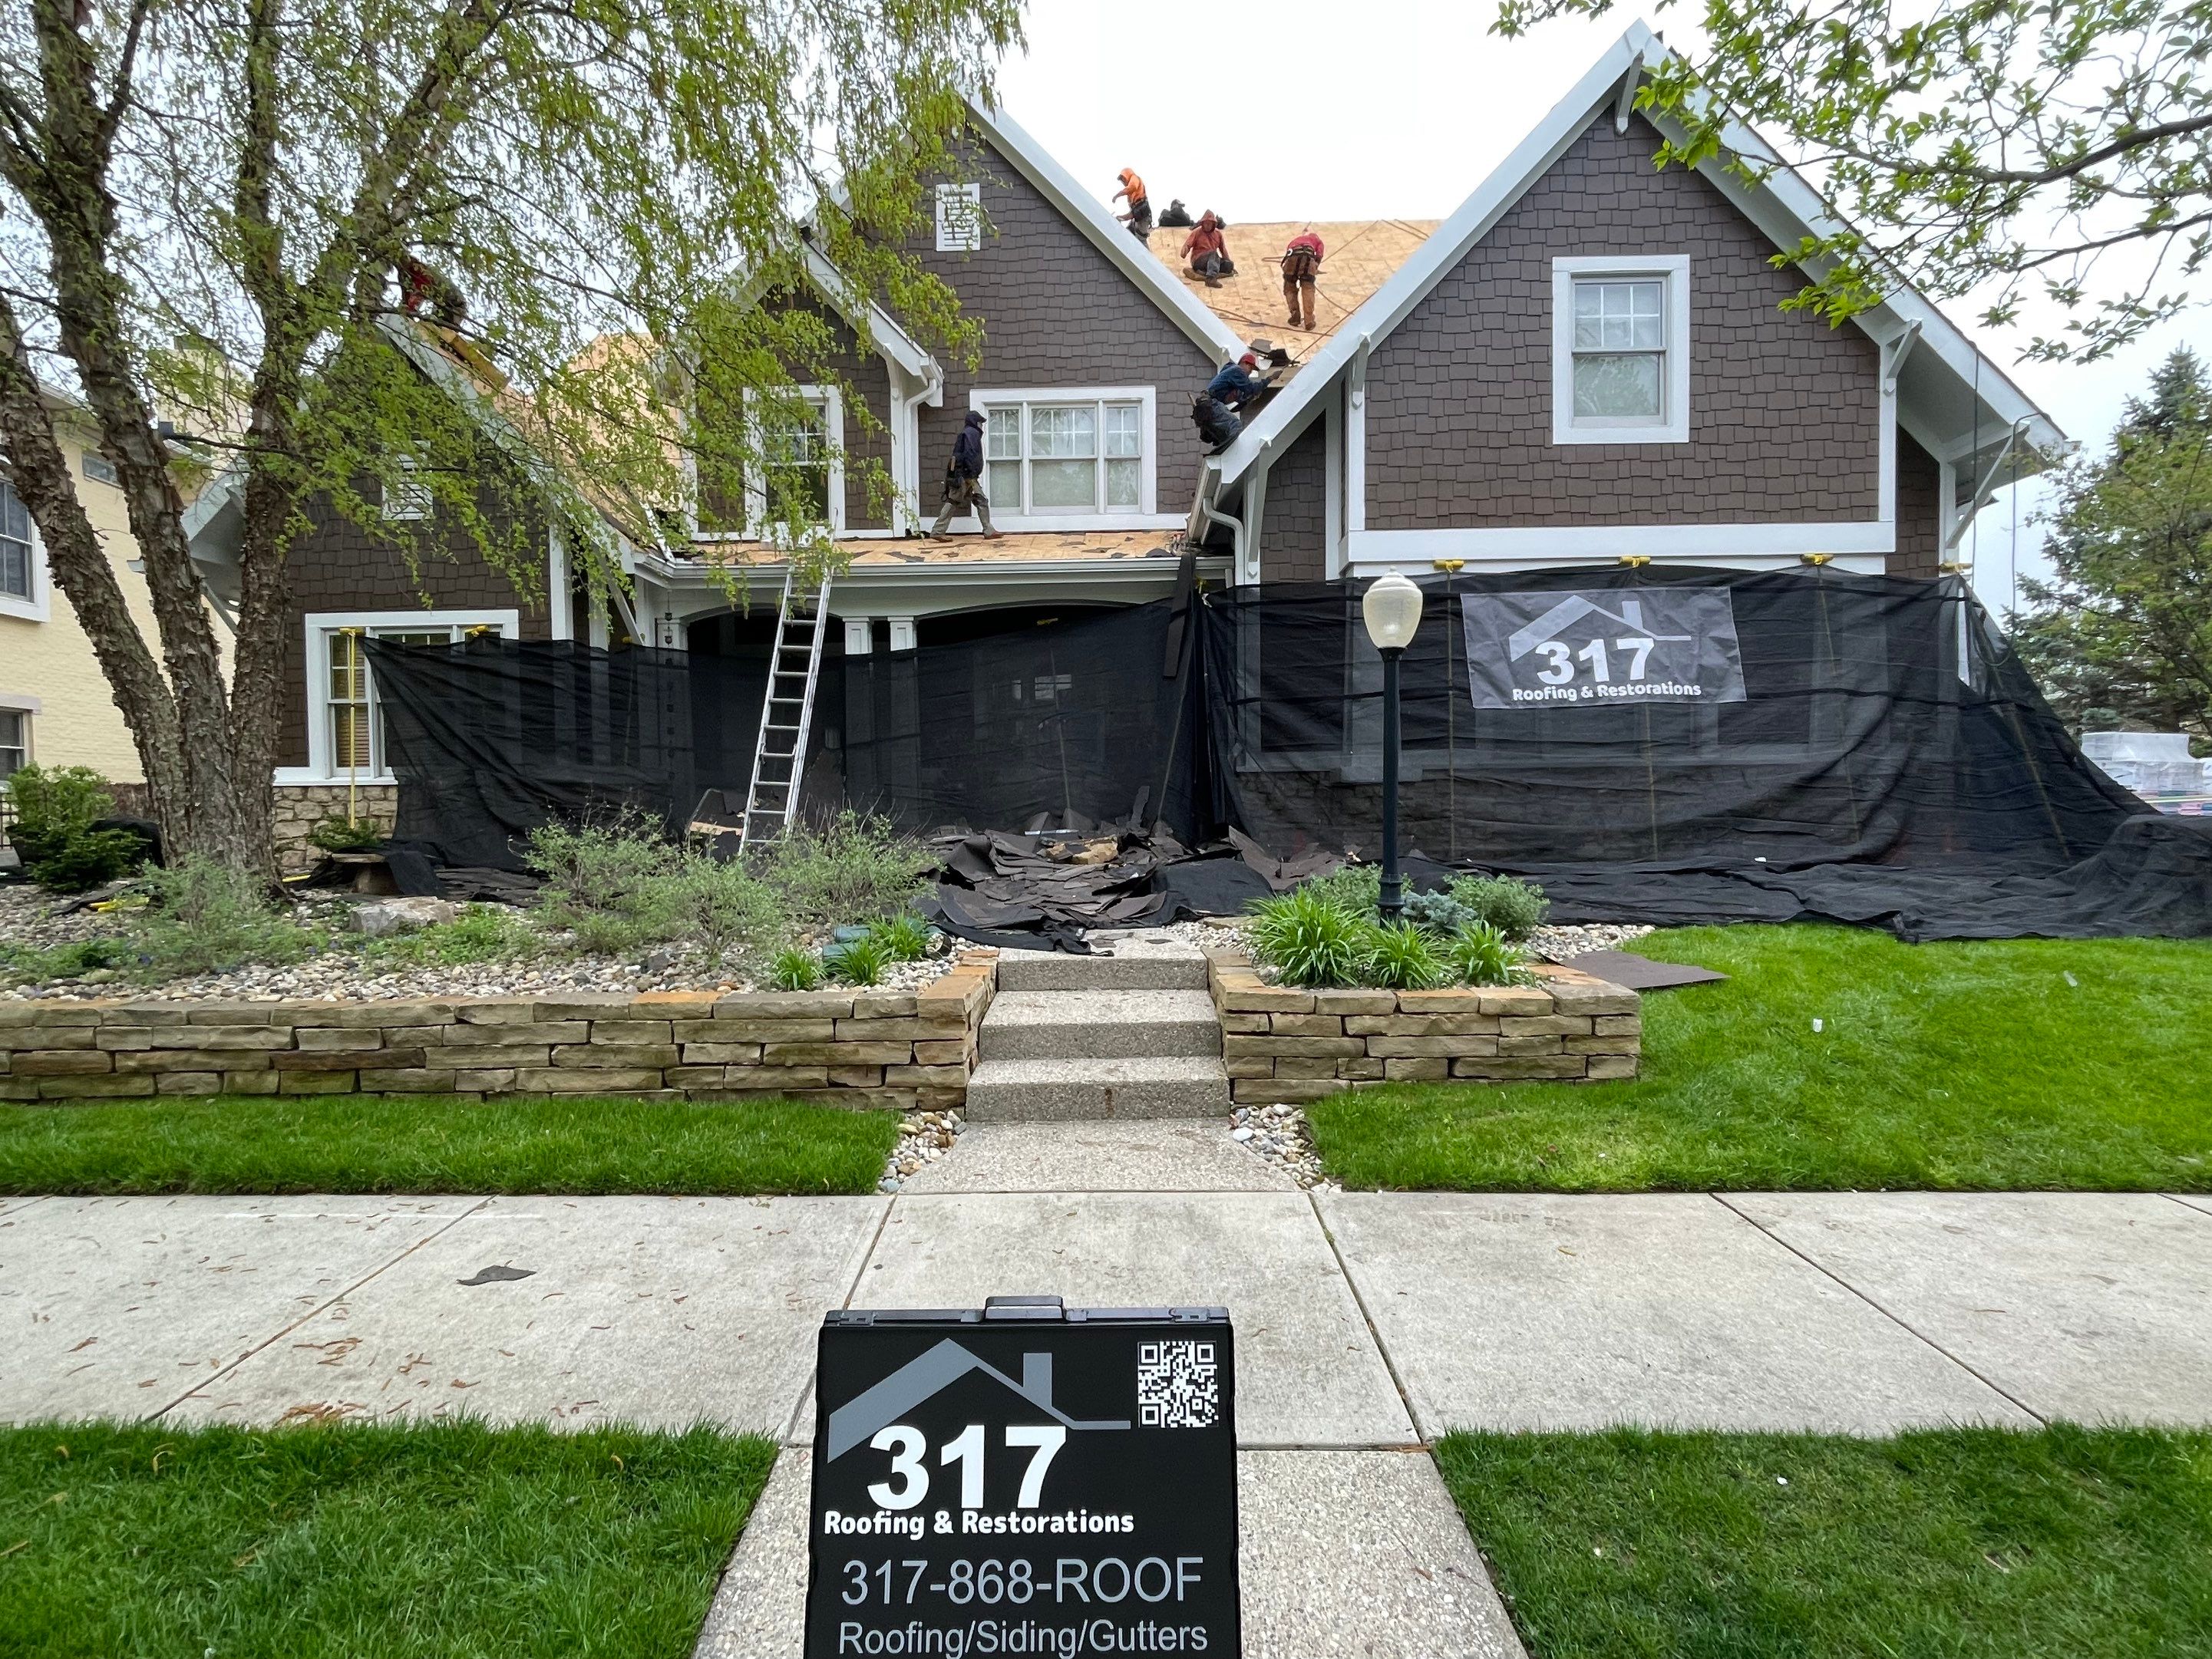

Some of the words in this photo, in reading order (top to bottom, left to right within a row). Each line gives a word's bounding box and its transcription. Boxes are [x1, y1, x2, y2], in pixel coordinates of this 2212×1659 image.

[1535, 638, 1654, 684] 317
[1512, 685, 1577, 701] Roofing
[1580, 684, 1594, 698] &
[1597, 681, 1702, 698] Restorations
[867, 1425, 1066, 1509] 317
[824, 1510, 925, 1540] Roofing
[933, 1510, 954, 1534] &
[962, 1509, 1134, 1534] Restorations
[841, 1557, 1203, 1605] 317-868-ROOF
[839, 1618, 1208, 1659] Roofing/Siding/Gutters
